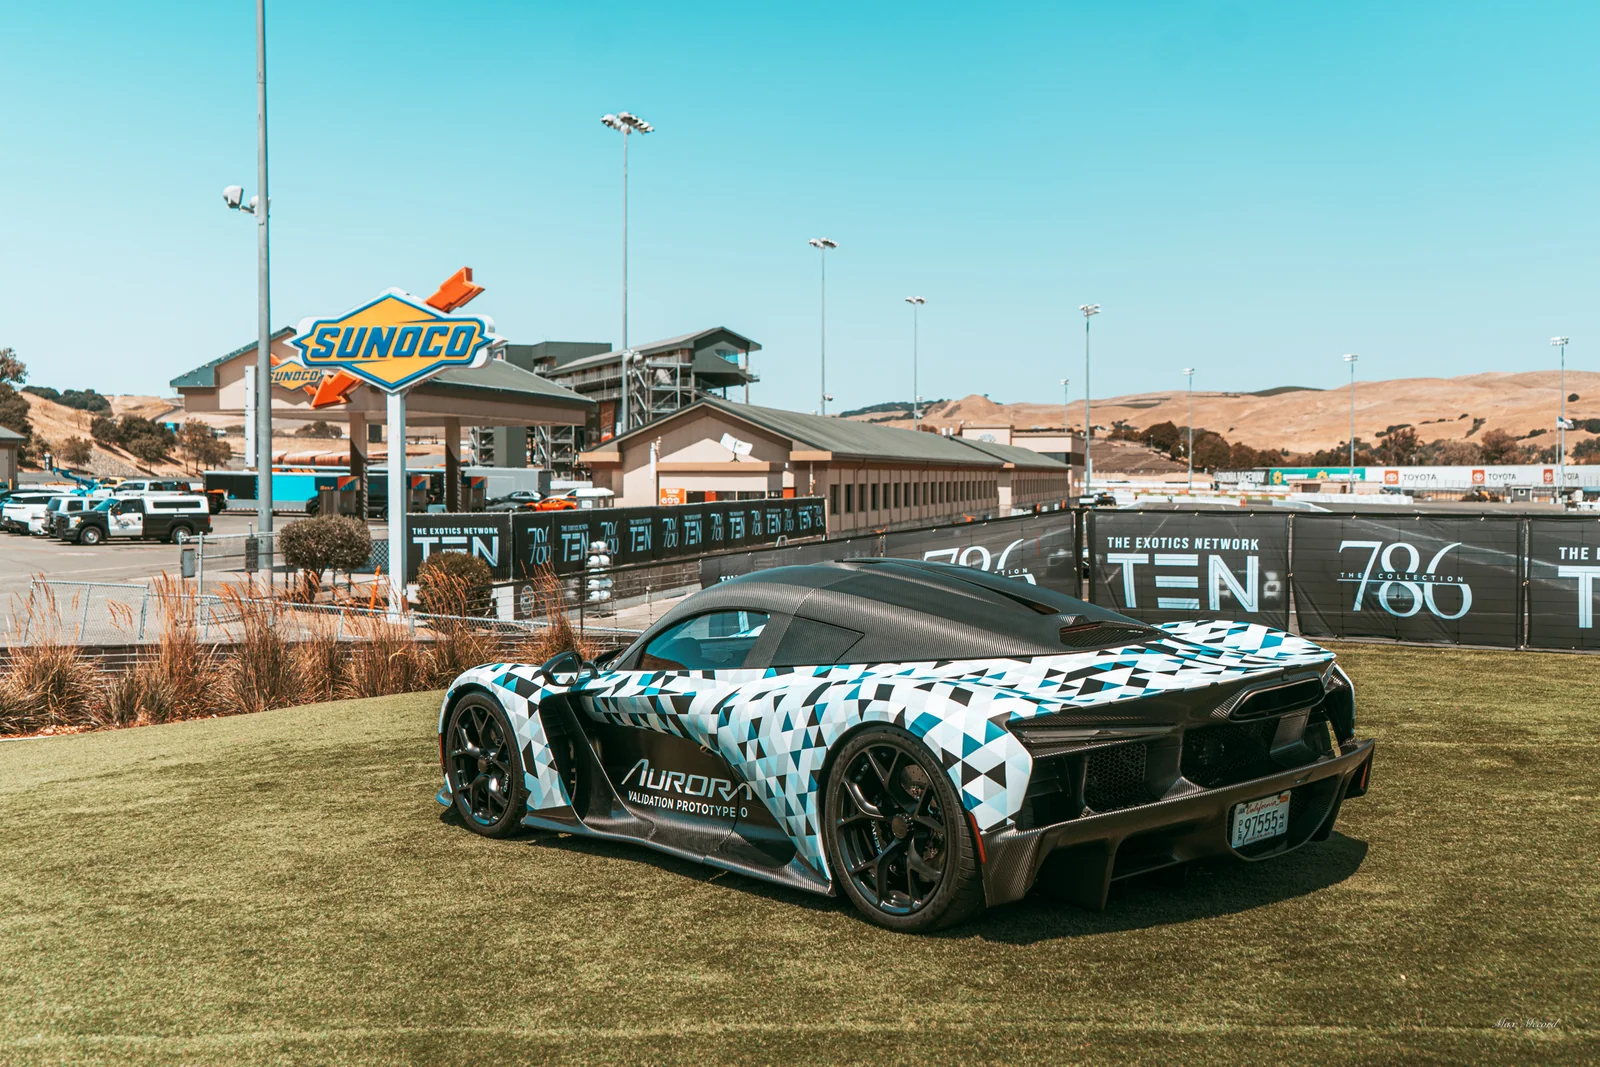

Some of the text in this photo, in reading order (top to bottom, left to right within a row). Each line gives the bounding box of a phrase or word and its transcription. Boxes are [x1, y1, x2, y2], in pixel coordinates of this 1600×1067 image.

[310, 325, 477, 358] SUNOCO
[270, 370, 319, 382] SUNOCO
[1403, 473, 1437, 481] TOYOTA
[412, 527, 427, 535] THE
[430, 527, 461, 535] EXOTICS
[662, 517, 679, 548] 786
[684, 520, 702, 545] TEN
[729, 517, 745, 539] TEN
[766, 513, 782, 533] TEN
[527, 526, 551, 564] 786
[561, 531, 589, 562] TEN
[629, 525, 651, 552] TEN
[1107, 537, 1259, 550] THE EXOTICS NETWORK
[1559, 547, 1589, 560] THE
[1107, 553, 1259, 613] TEN
[1338, 540, 1473, 620] 786
[1378, 573, 1464, 582] COLLECTION
[621, 758, 753, 802] AURORA
[628, 790, 674, 810] VALIDATION
[676, 799, 736, 818] PROTOTYPE
[1245, 799, 1281, 815] California
[1243, 809, 1278, 838] 97555
